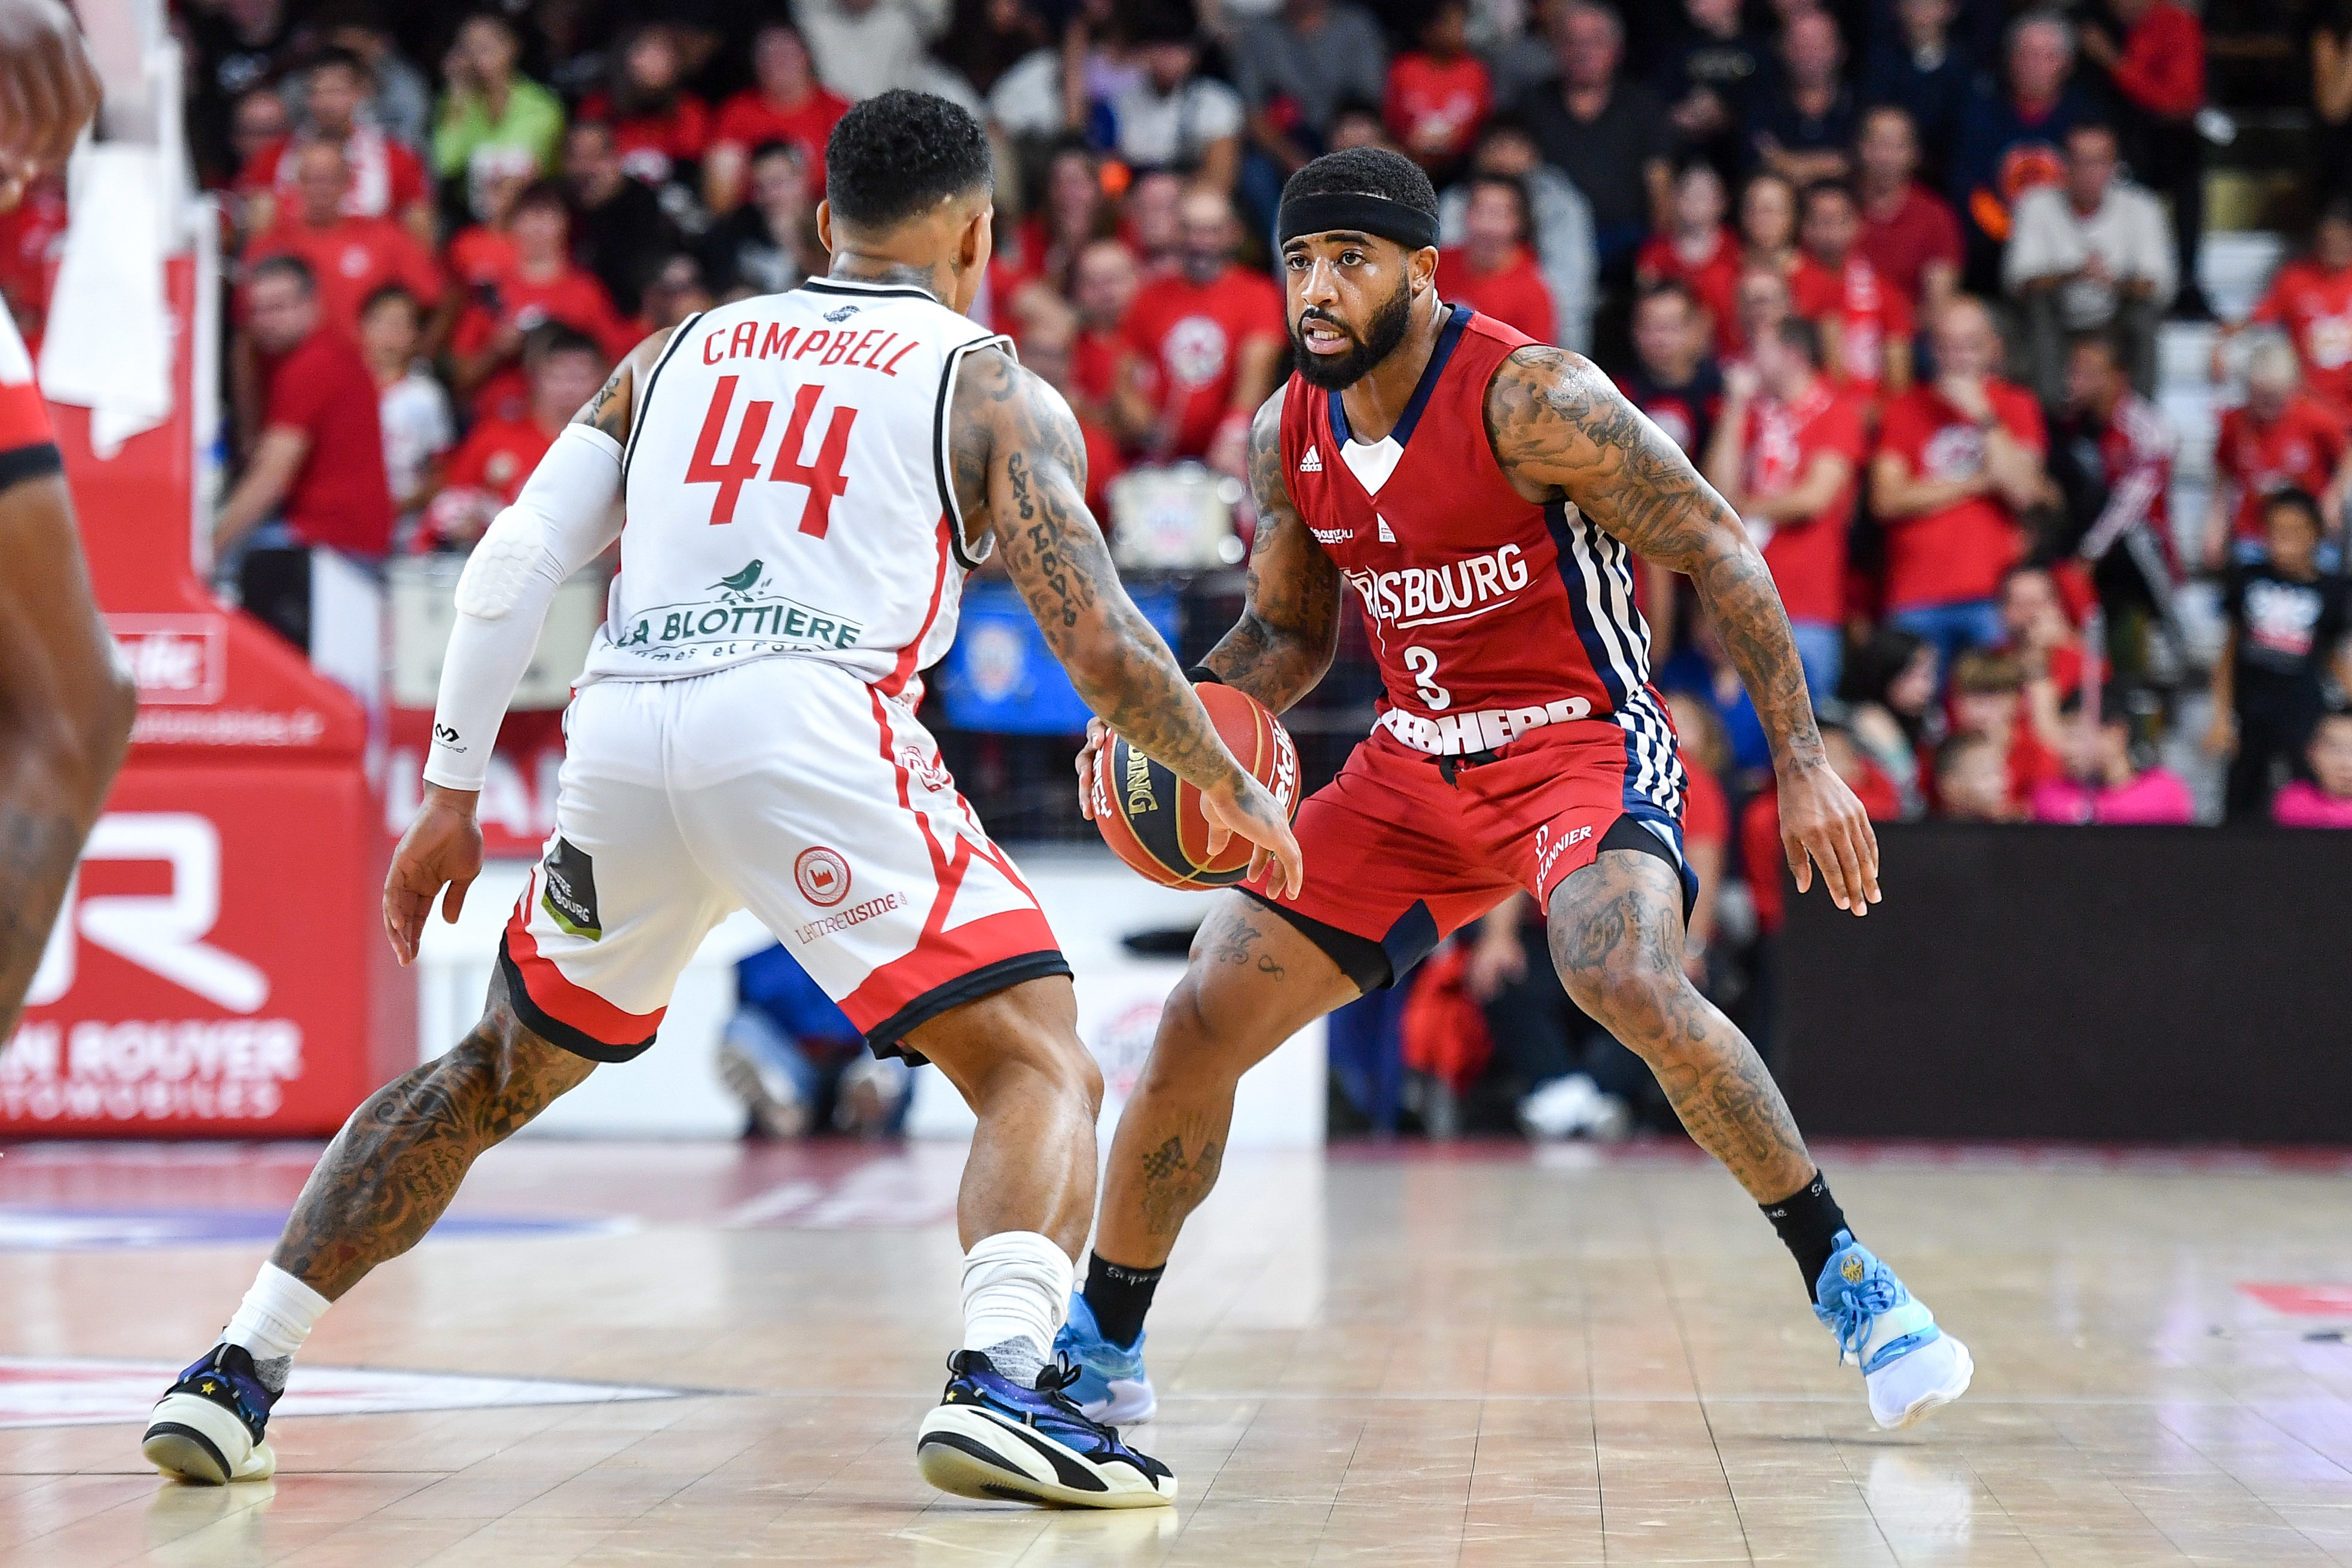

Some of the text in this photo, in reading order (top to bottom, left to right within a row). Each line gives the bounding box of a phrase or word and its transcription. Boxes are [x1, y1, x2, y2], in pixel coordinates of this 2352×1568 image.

[703, 321, 920, 377] CAMPBELL
[684, 374, 859, 540] 44
[660, 604, 864, 650] BLOTTIERE
[1404, 645, 1452, 710] 3
[68, 1018, 304, 1081] ROUYER
